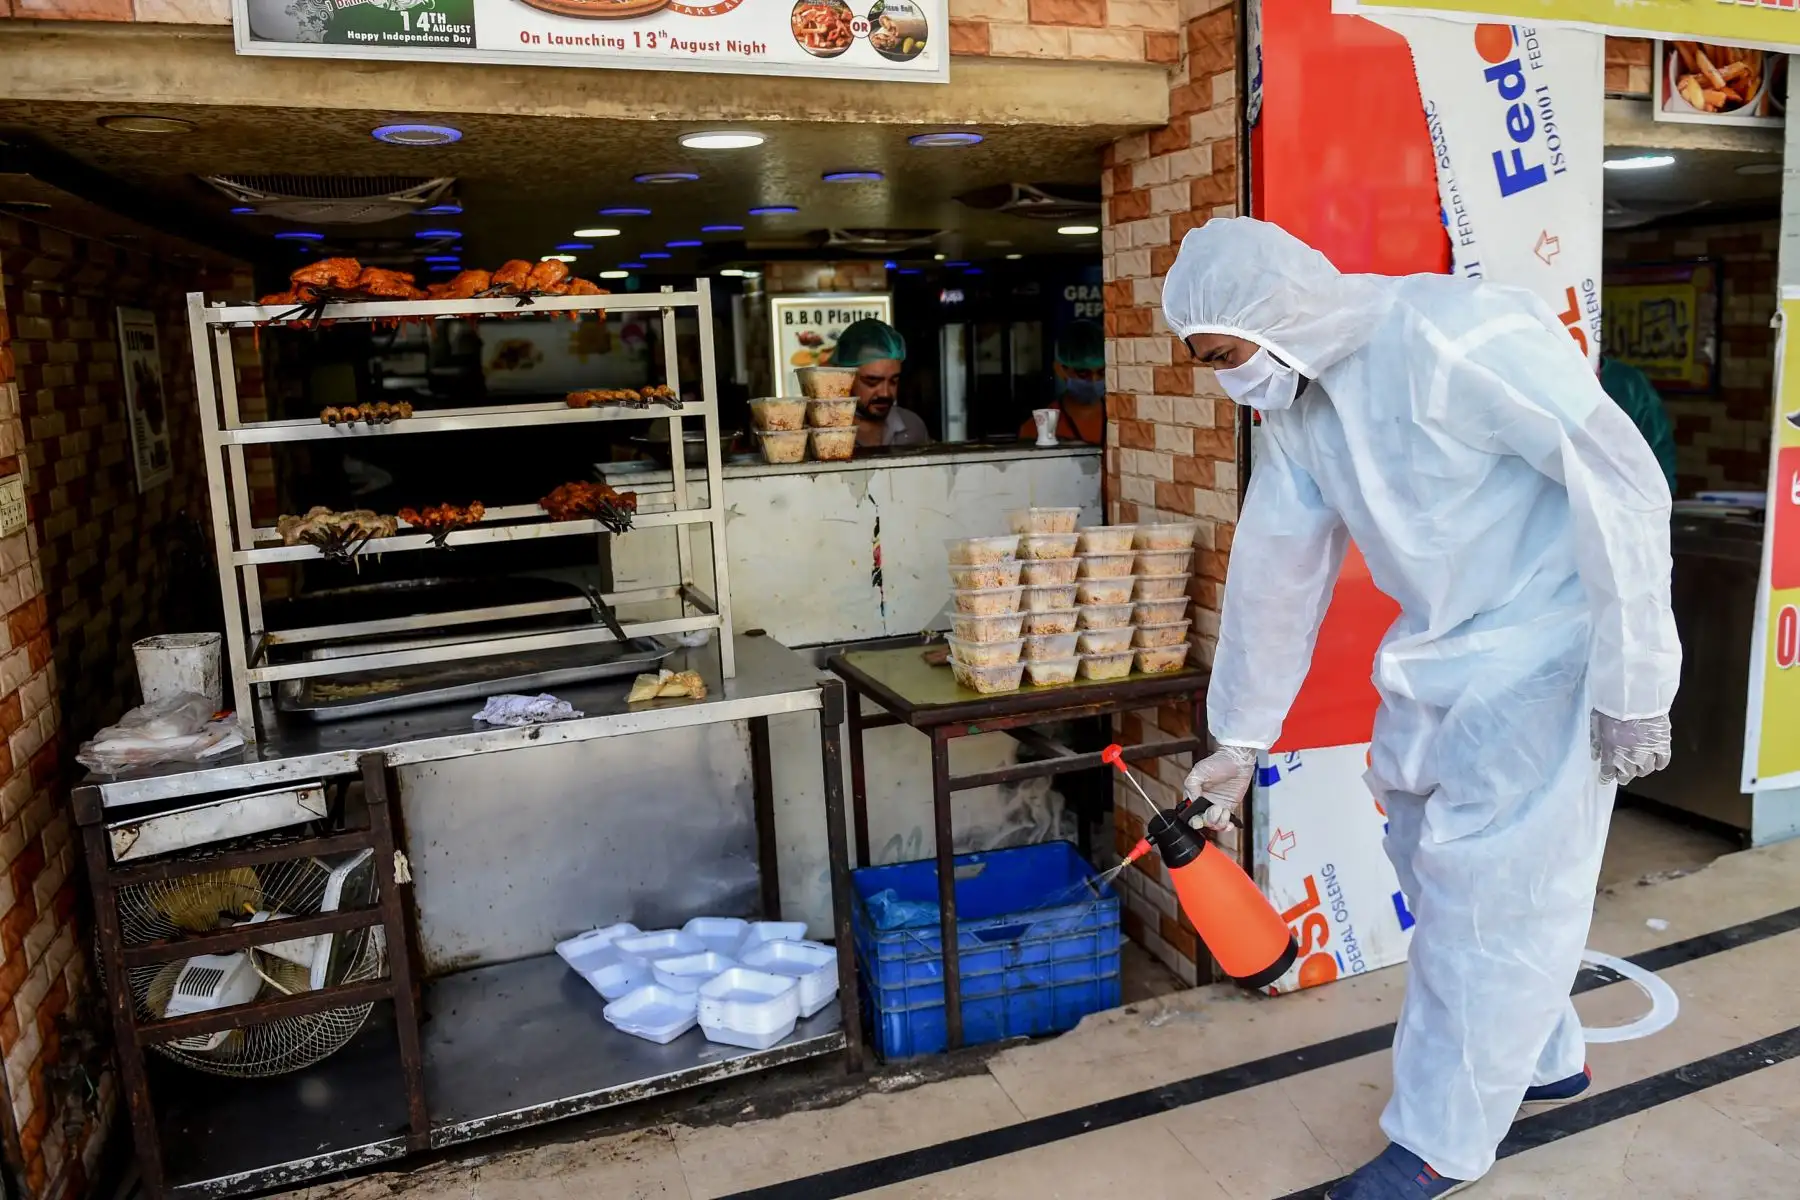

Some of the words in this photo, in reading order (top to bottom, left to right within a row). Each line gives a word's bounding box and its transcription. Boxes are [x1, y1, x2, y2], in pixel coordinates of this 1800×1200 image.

[674, 4, 717, 15] TAKE
[433, 24, 471, 33] AUGUST
[852, 22, 868, 32] OR
[347, 30, 379, 41] Happy
[382, 32, 450, 42] Independence
[453, 34, 471, 44] Day
[520, 31, 541, 44] On
[547, 32, 625, 50] Launching
[670, 38, 720, 53] August
[727, 40, 767, 55] Night
[1522, 26, 1544, 70] FEDE
[1535, 85, 1567, 175] ISO9001
[1321, 863, 1349, 924] OSLENG
